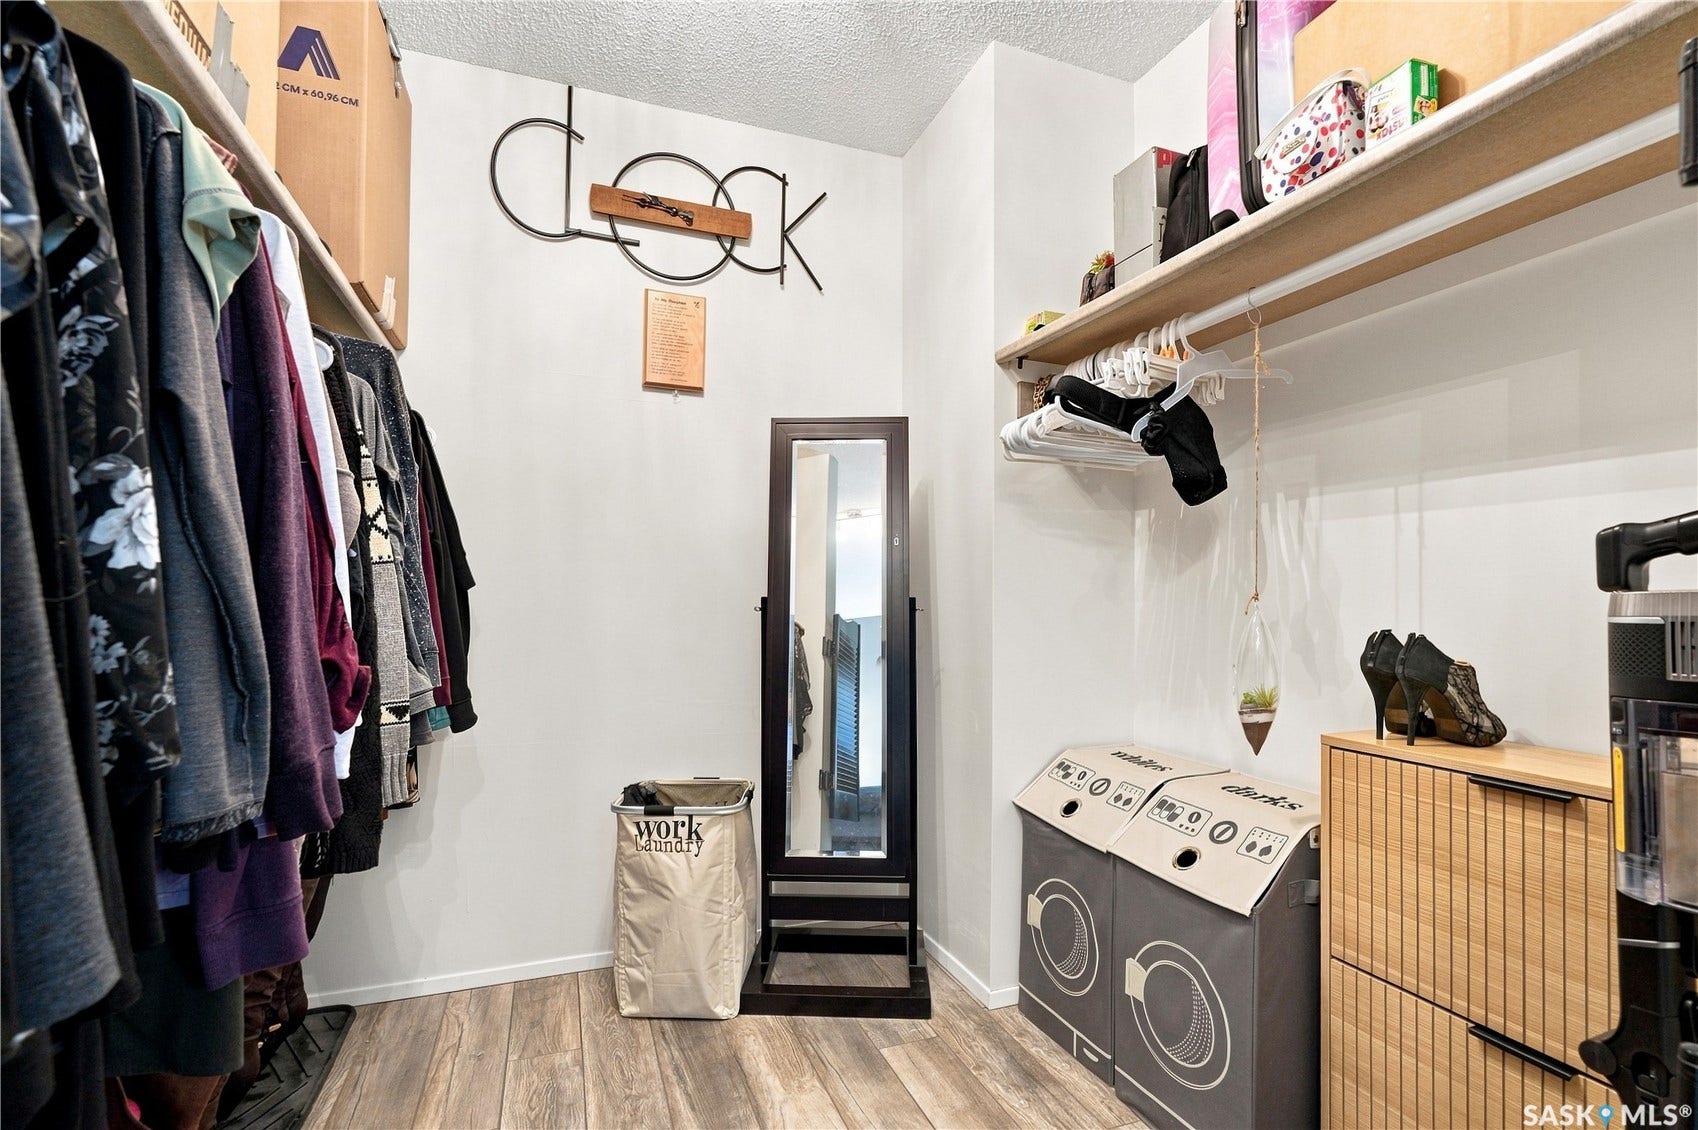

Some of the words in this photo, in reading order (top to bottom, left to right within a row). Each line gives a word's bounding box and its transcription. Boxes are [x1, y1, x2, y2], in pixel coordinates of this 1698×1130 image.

[281, 83, 300, 94] CM
[340, 96, 359, 107] CM
[1221, 785, 1304, 811] darks
[632, 815, 704, 841] work
[634, 834, 705, 857] Laundry
